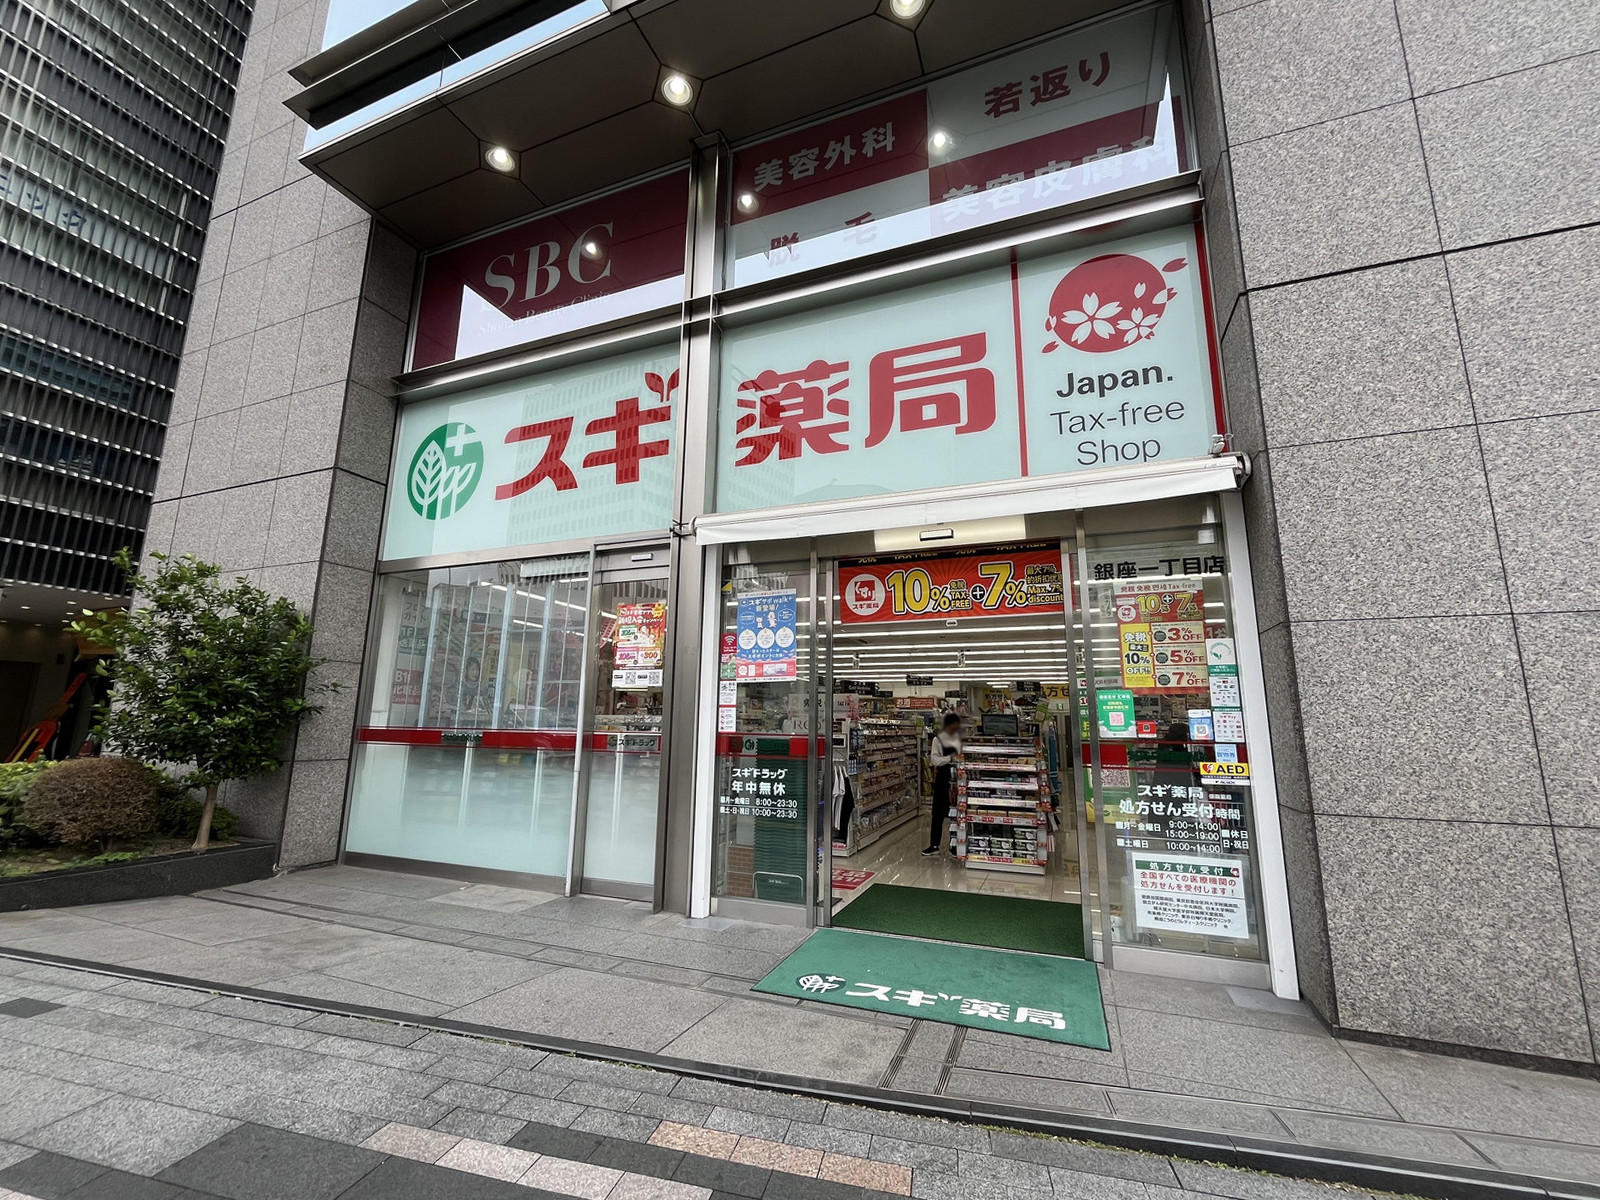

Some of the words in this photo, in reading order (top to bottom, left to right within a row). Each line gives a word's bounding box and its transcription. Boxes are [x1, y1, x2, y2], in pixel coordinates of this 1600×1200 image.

[984, 51, 1112, 119] 若返り
[754, 121, 896, 193] 美容外科
[942, 133, 1176, 222] 美容皮膚科
[483, 221, 614, 311] SBC
[1056, 363, 1174, 399] Japan.
[1051, 399, 1185, 436] Tax-free
[1077, 435, 1162, 467] Shop
[1094, 556, 1225, 580] 銀座一丁目店
[887, 568, 950, 614] 10%
[981, 563, 1026, 607] 7%
[1168, 582, 1196, 590] Tax-free
[951, 599, 971, 609] FREE
[1028, 593, 1064, 604] discount
[1124, 632, 1147, 643] 免税
[1167, 627, 1193, 643] 3%
[1125, 653, 1151, 664] 10%
[1170, 649, 1194, 663] 5%
[1172, 672, 1197, 685] 7%
[1187, 678, 1207, 686] OFF
[732, 768, 788, 779] スギドラッグ
[1216, 764, 1245, 774] AED
[731, 780, 786, 796] 年中無休
[1137, 784, 1204, 799] スギ薬局
[1119, 799, 1241, 820] 処方せん受付時間
[1150, 861, 1224, 876] 処方せん受付
[1140, 871, 1237, 887] 全国すべての医療機関の
[845, 982, 1067, 1030] スギ薬局
